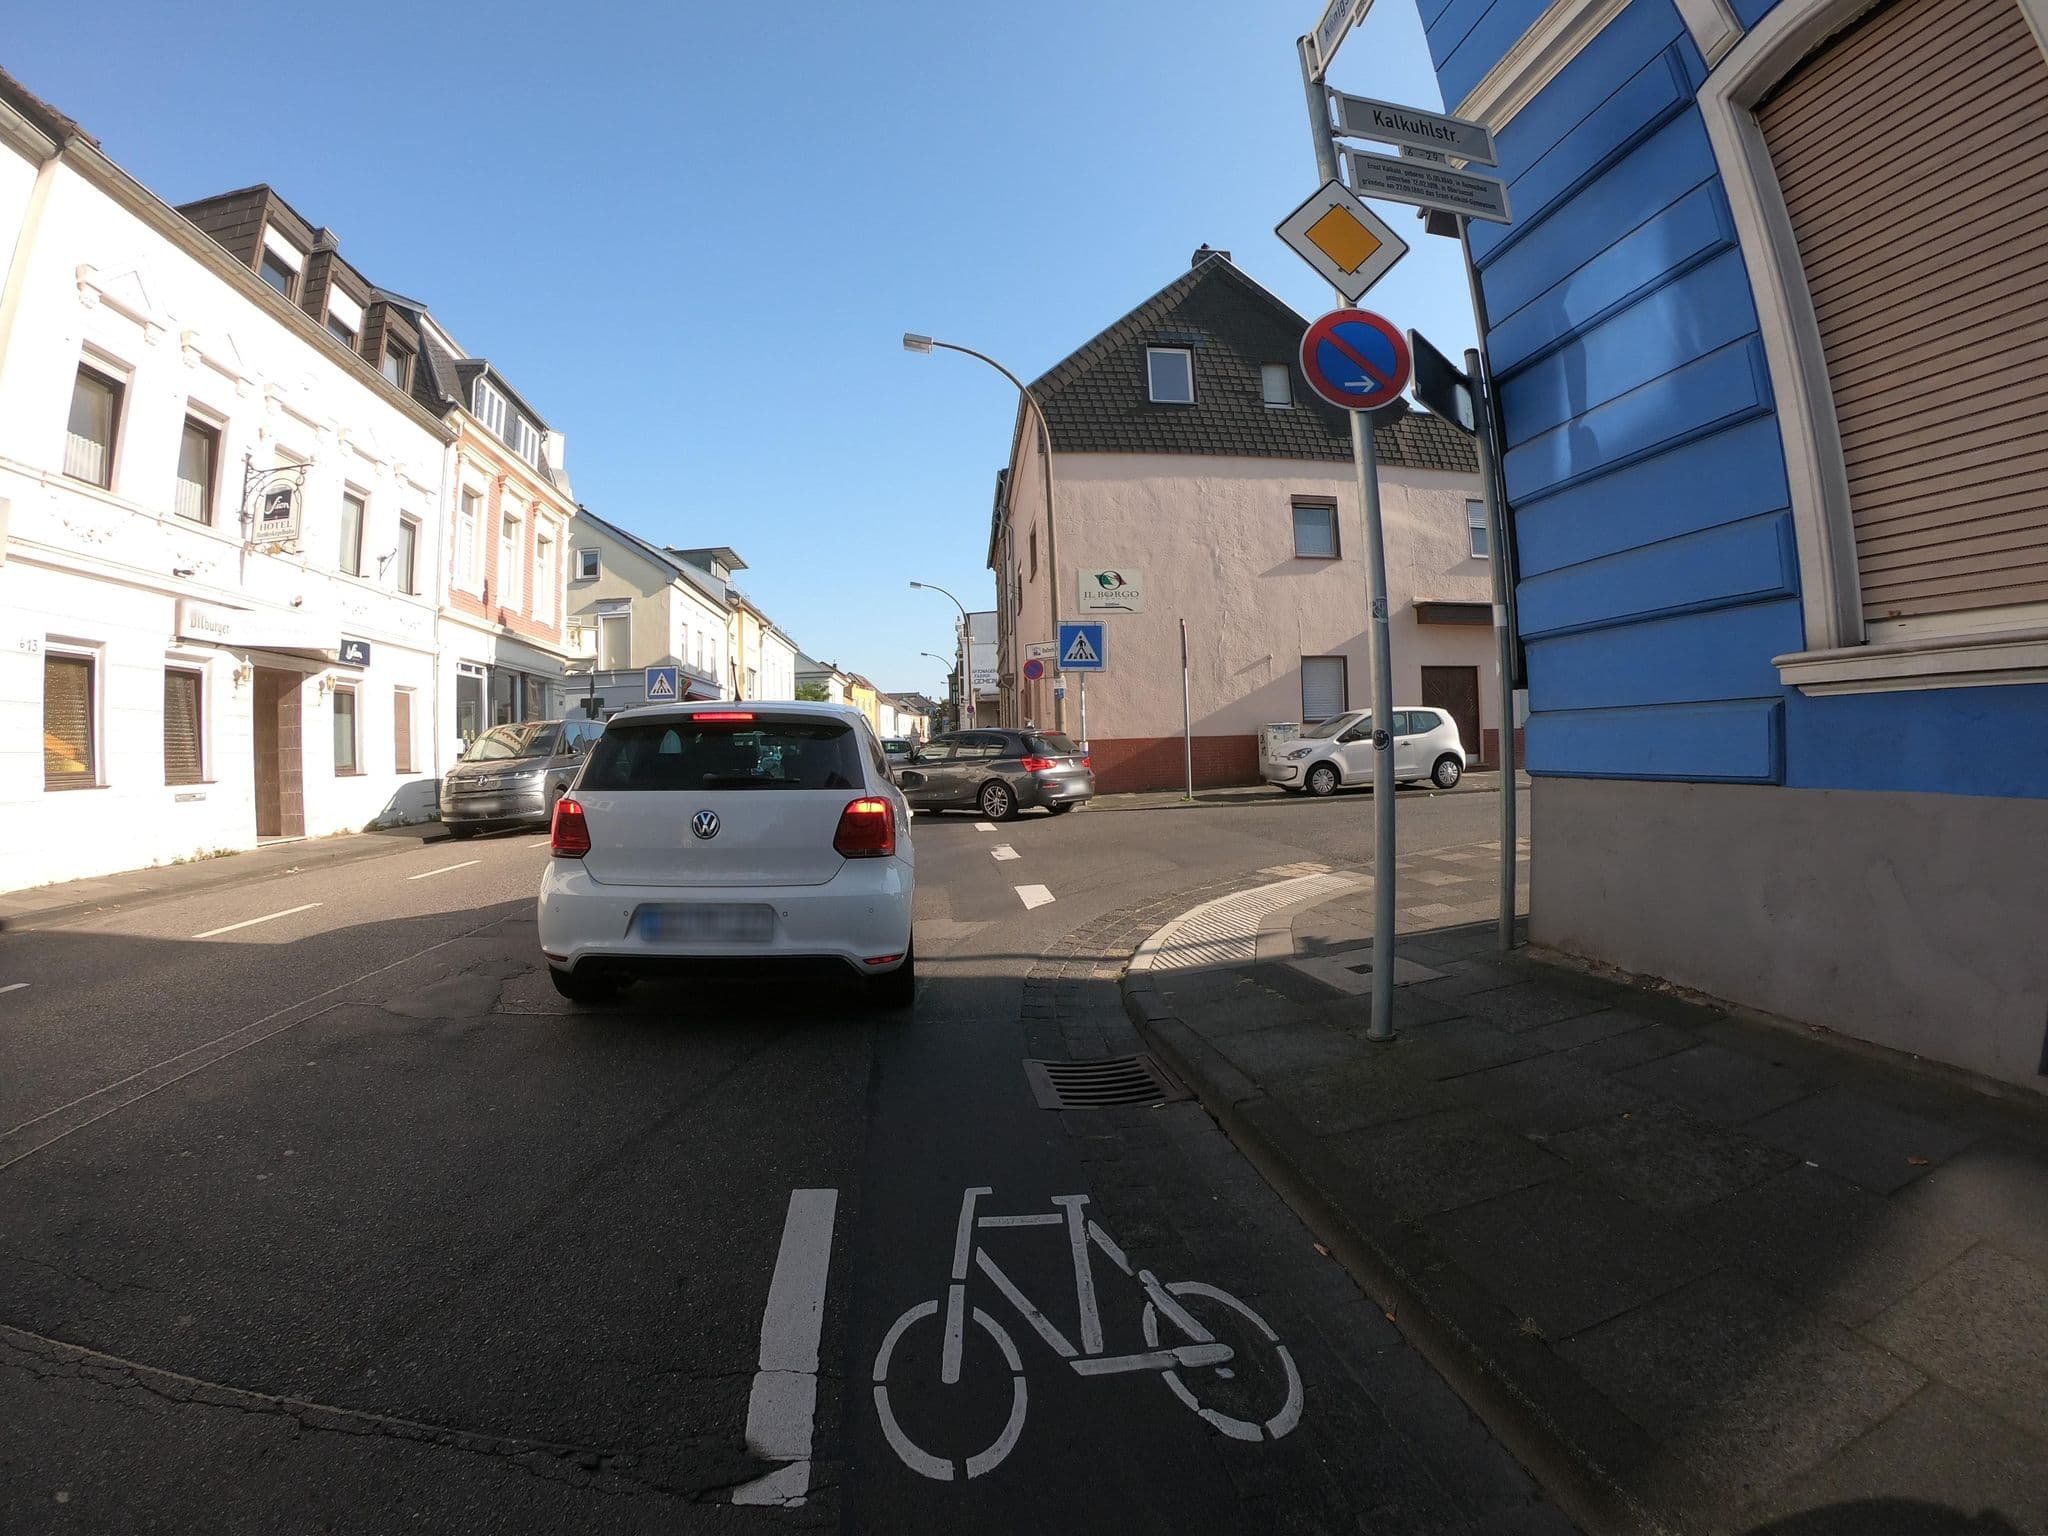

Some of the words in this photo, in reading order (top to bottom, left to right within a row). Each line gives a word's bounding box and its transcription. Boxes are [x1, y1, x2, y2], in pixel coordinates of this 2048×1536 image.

[1373, 110, 1460, 143] Kalkuhlstr.
[259, 520, 293, 531] HOTEL
[1098, 590, 1140, 599] BORGO
